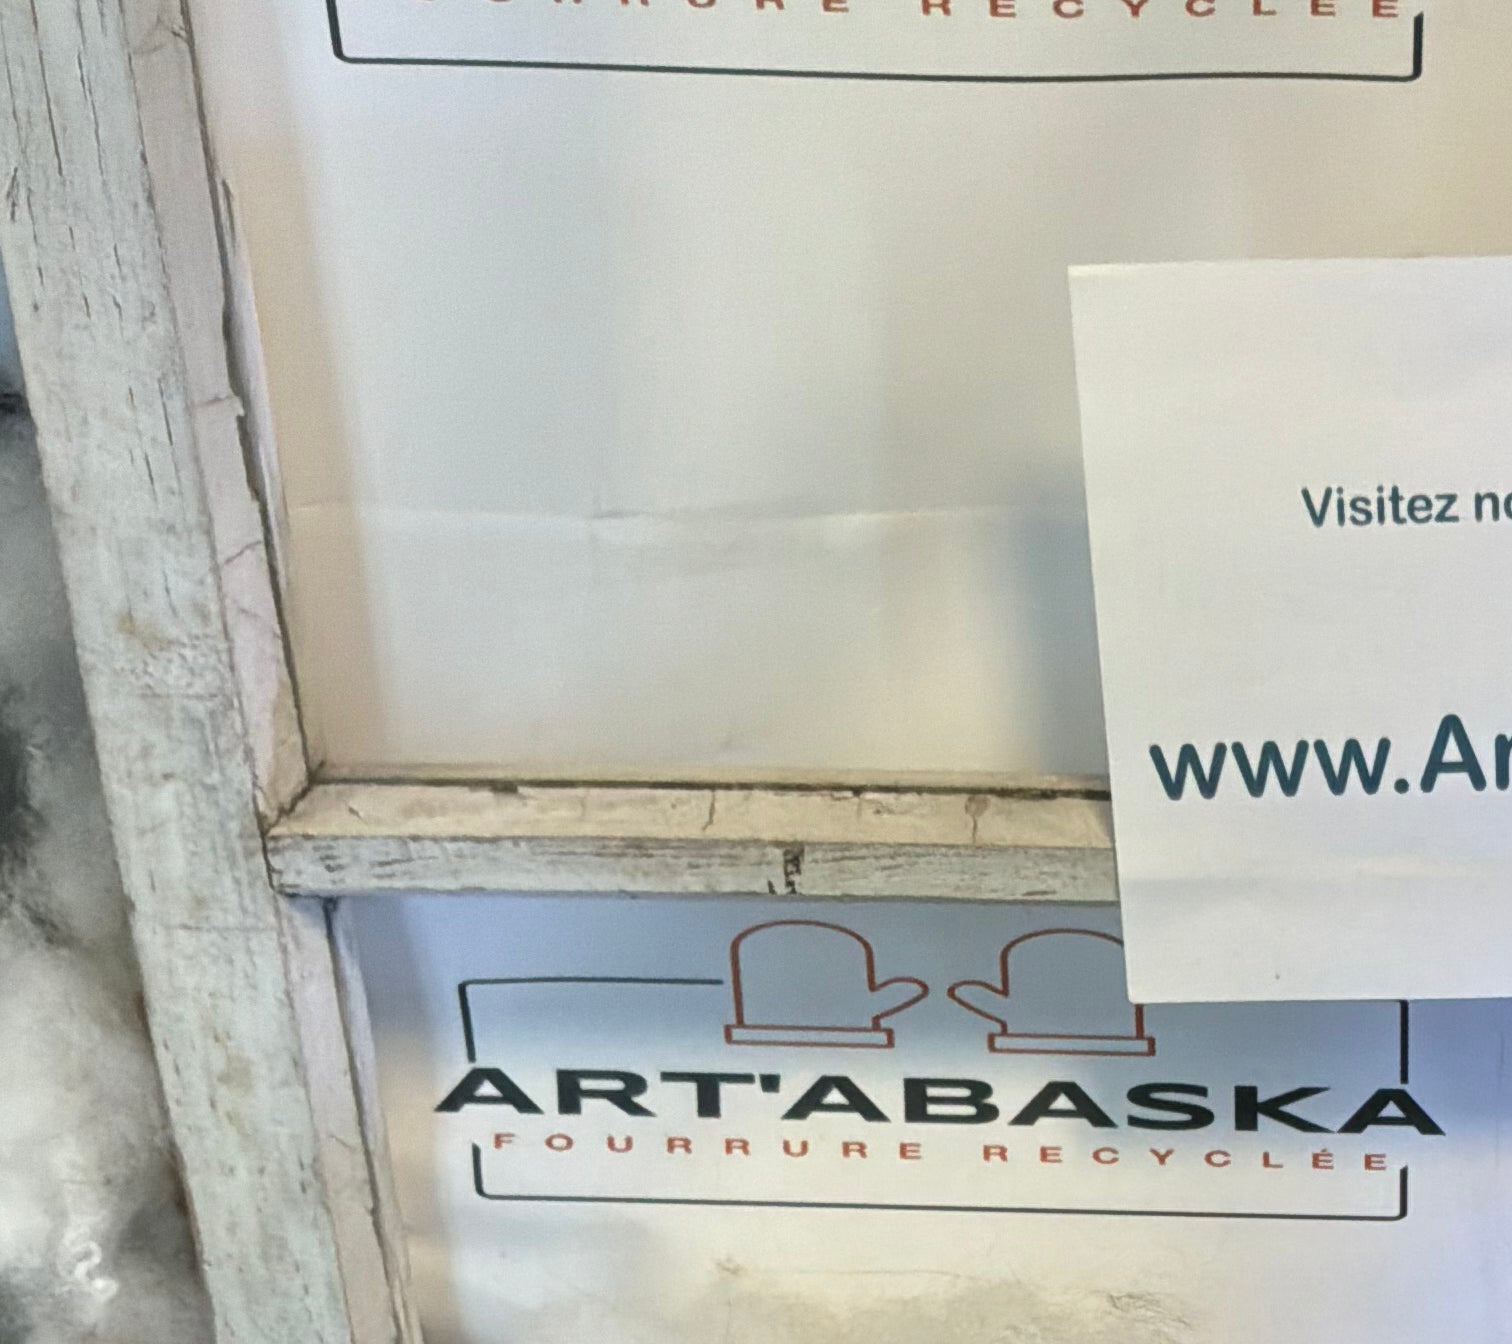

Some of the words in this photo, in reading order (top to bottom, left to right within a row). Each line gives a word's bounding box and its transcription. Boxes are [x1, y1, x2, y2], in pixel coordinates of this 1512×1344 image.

[1301, 484, 1459, 527] Visitez
[435, 1067, 1446, 1136] ART'ABASKA
[493, 1133, 924, 1162] FOURRURE
[981, 1144, 1389, 1172] RECYCLÉE
